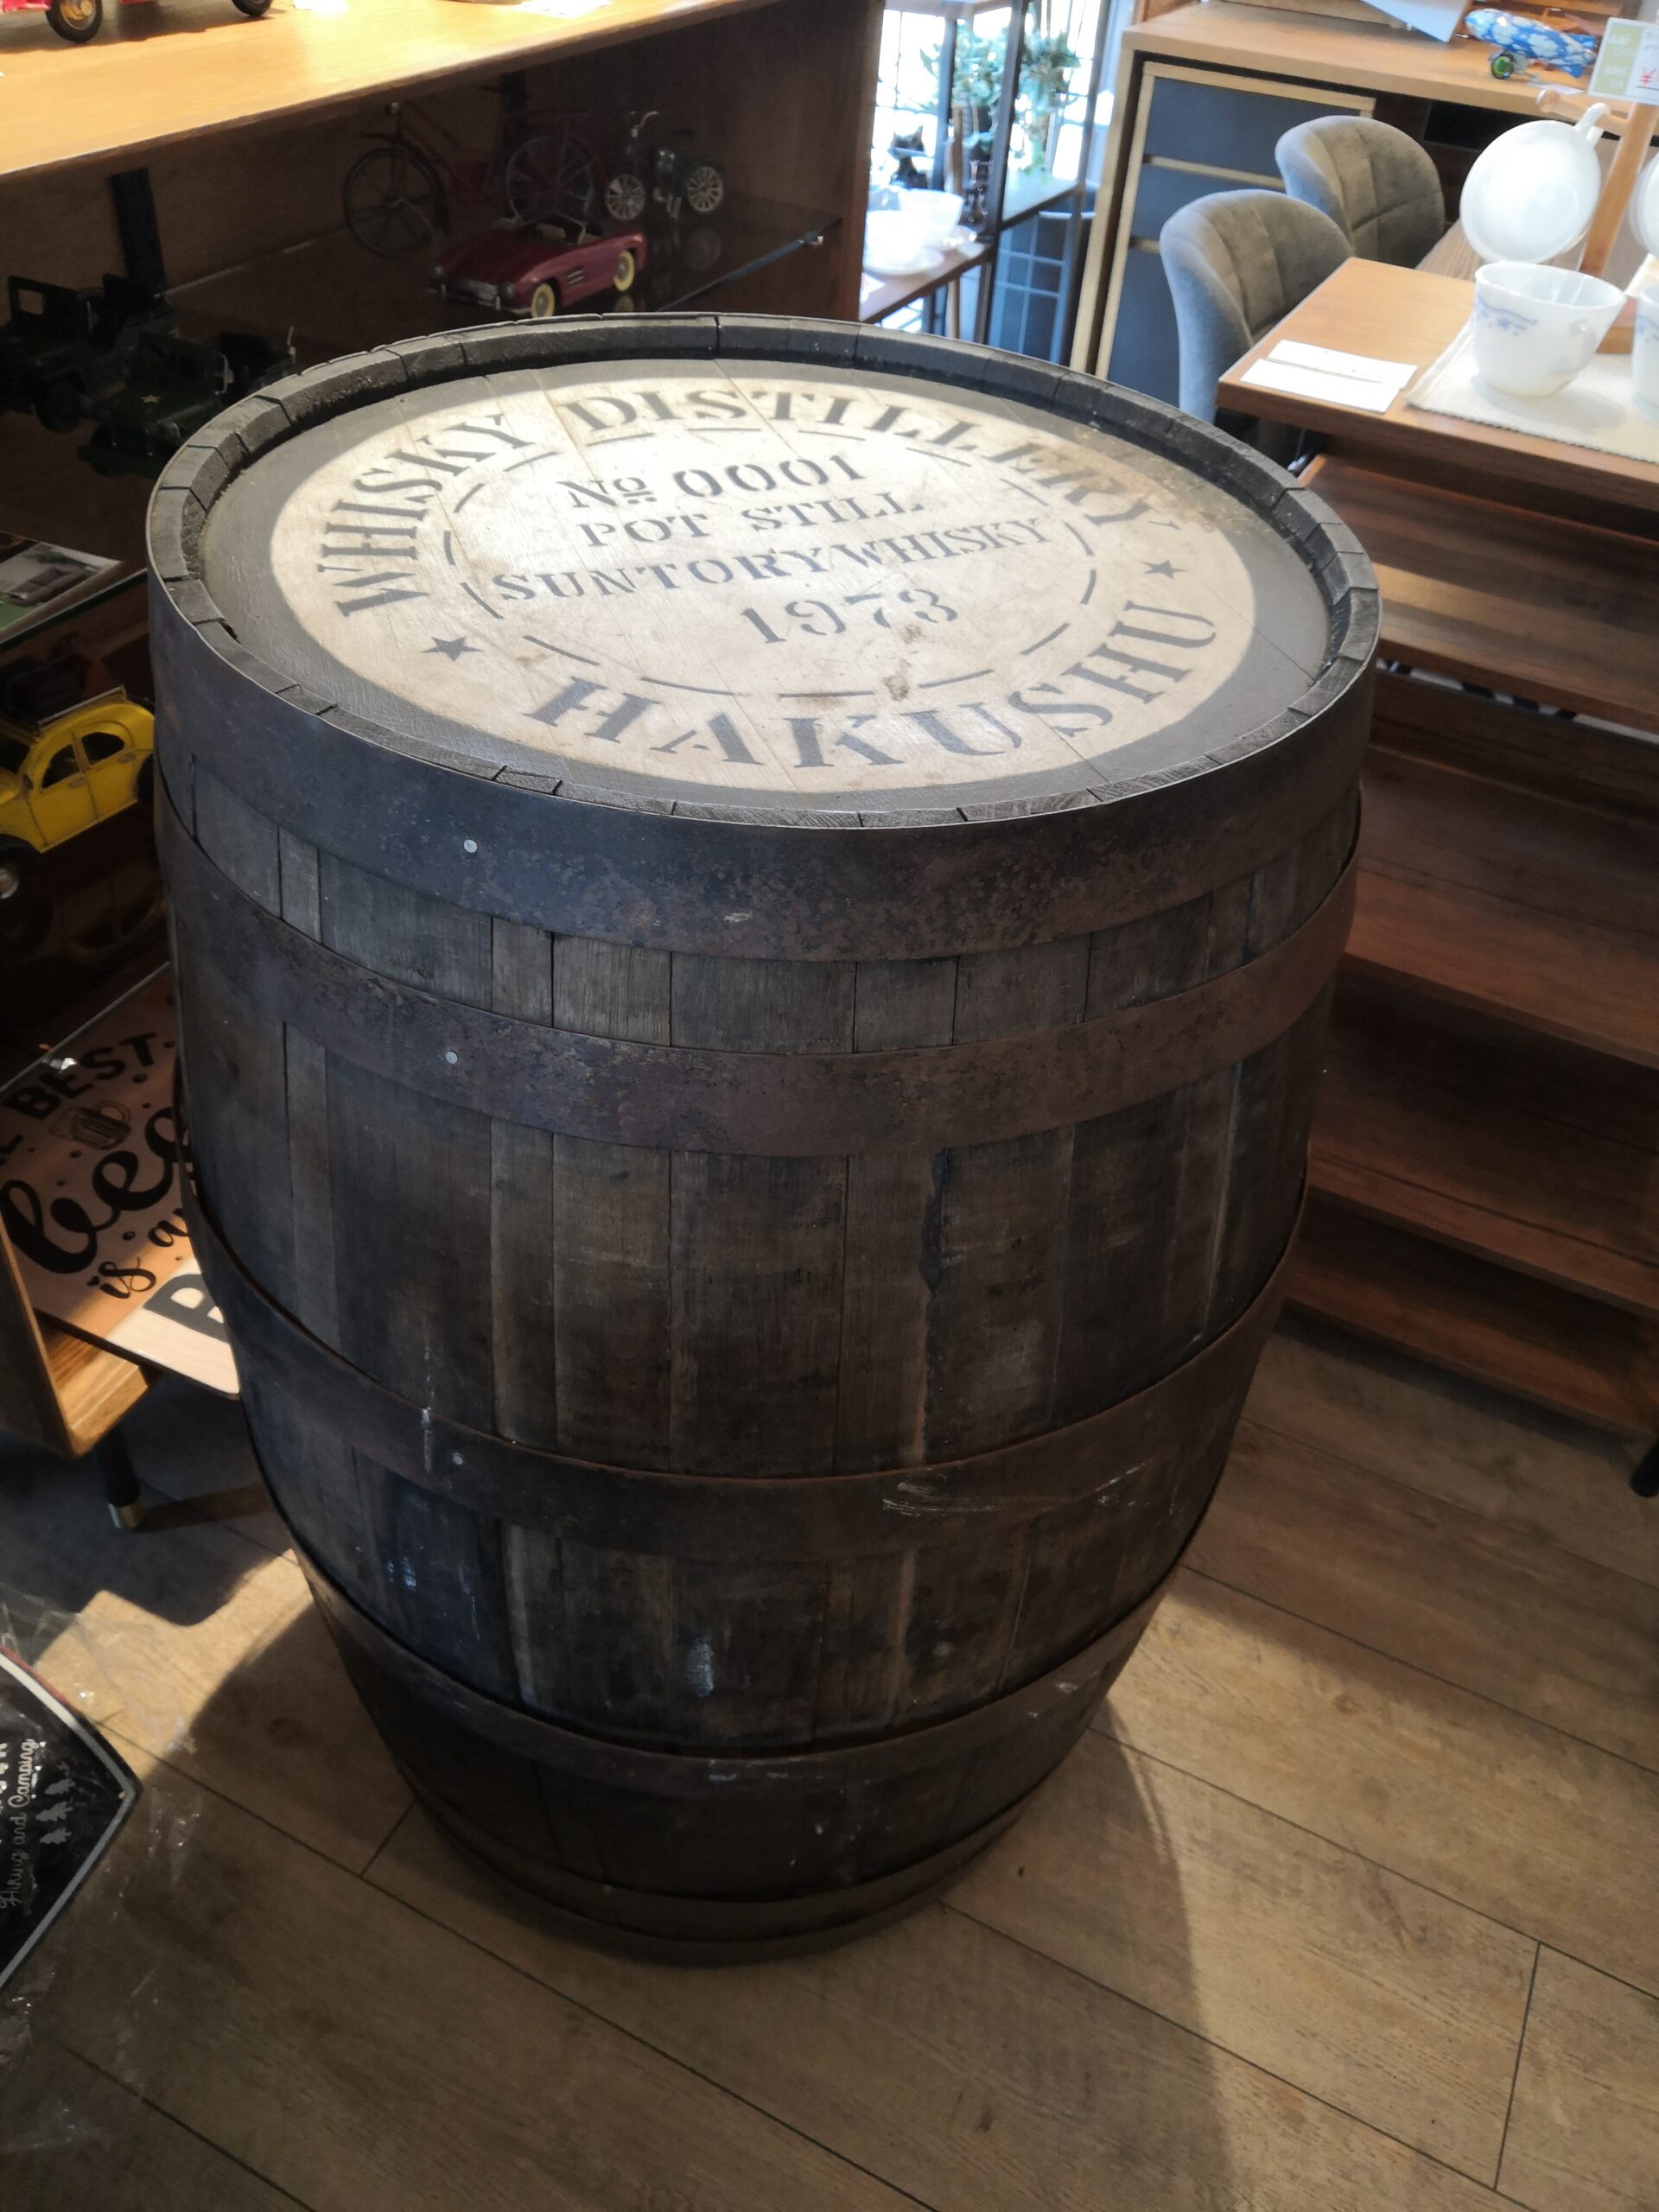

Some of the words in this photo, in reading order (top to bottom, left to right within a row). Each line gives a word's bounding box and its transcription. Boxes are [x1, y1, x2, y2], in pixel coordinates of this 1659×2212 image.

[317, 414, 536, 617] WHISKY
[560, 389, 1180, 530] DISTILLERY
[673, 454, 866, 499] 0001
[579, 512, 710, 548] POT
[741, 492, 925, 532] STILL
[741, 589, 958, 644] 1973
[523, 598, 1217, 769] HAKUSHU
[87, 1257, 156, 1299] is
[8, 1738, 40, 1808] Camping
